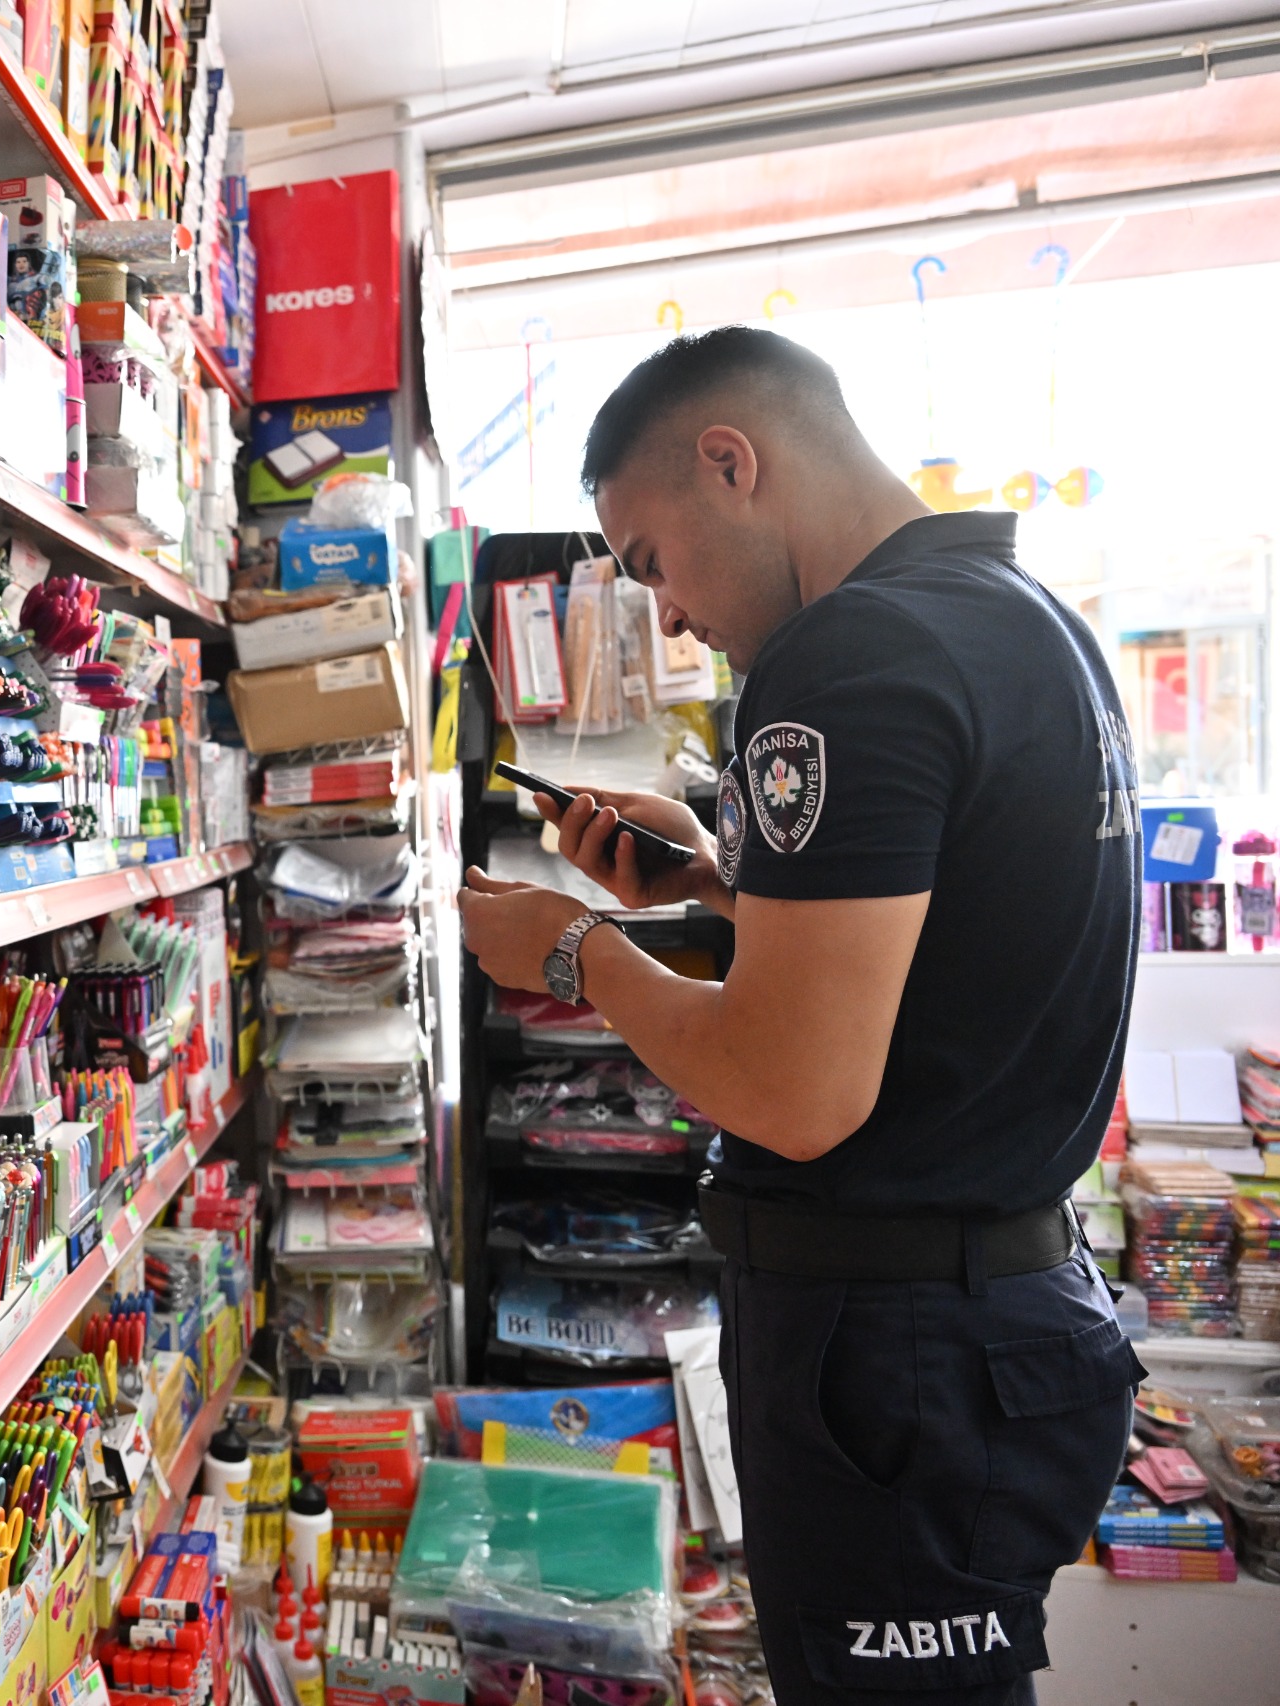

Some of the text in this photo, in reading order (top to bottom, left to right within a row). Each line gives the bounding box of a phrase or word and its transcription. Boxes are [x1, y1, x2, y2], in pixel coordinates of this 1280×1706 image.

[291, 405, 368, 432] Brons
[752, 730, 810, 760] MANİSA
[789, 758, 819, 840] BELEDİYESİ
[508, 1314, 537, 1335] BE
[846, 1610, 1012, 1658] ZABITA
